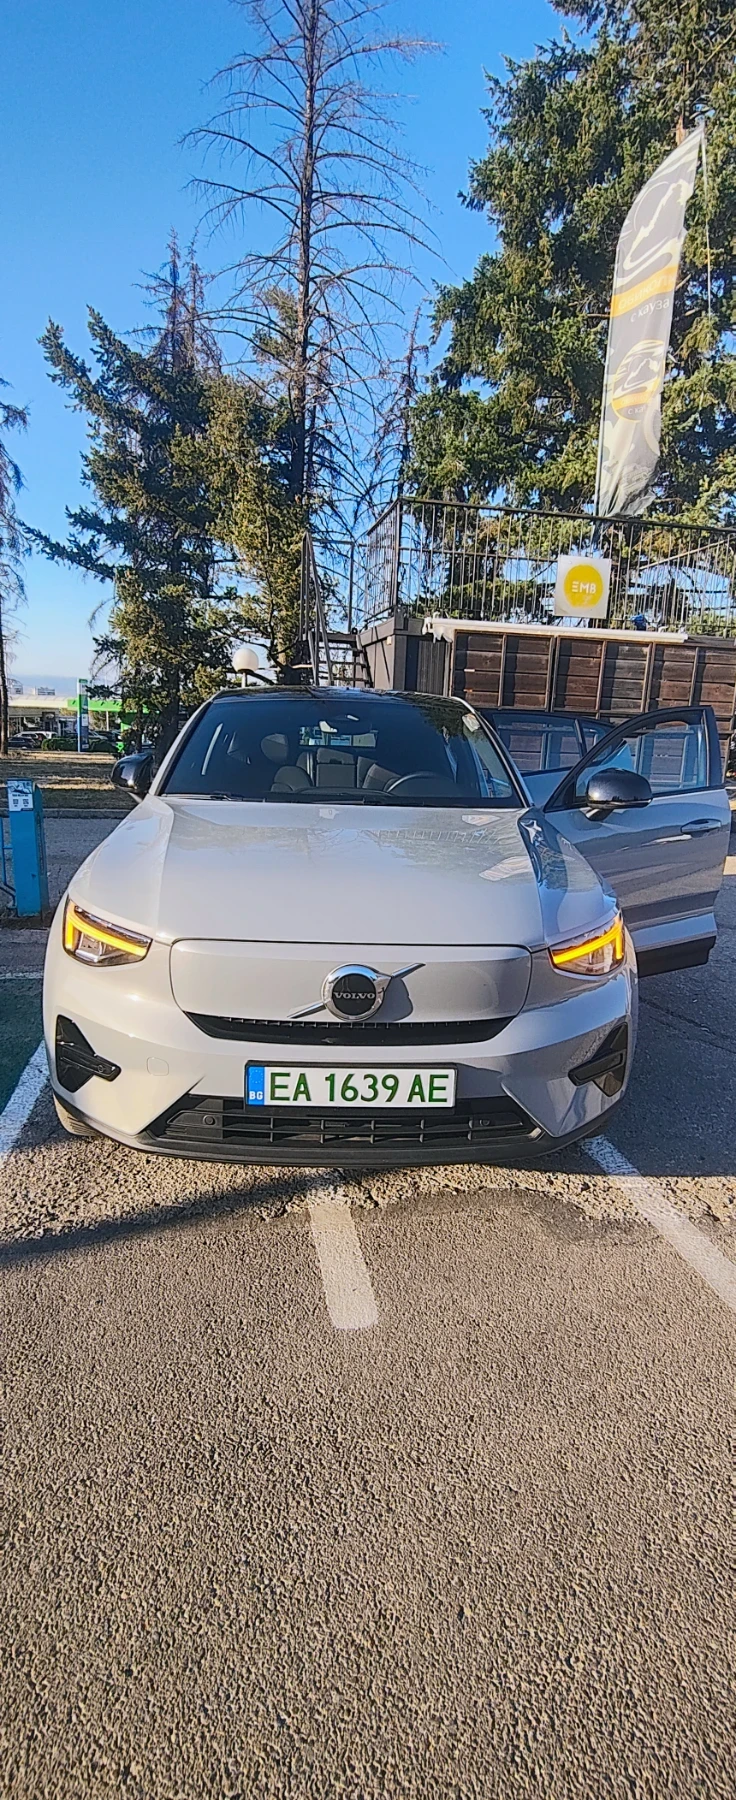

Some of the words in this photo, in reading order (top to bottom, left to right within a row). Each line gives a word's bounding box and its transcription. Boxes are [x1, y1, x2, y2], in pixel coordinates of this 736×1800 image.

[638, 298, 670, 318] кауза
[571, 580, 597, 594] EMB
[249, 1091, 264, 1100] BG
[270, 1072, 312, 1102] EA
[325, 1073, 399, 1103] 1639
[407, 1074, 450, 1103] AE
